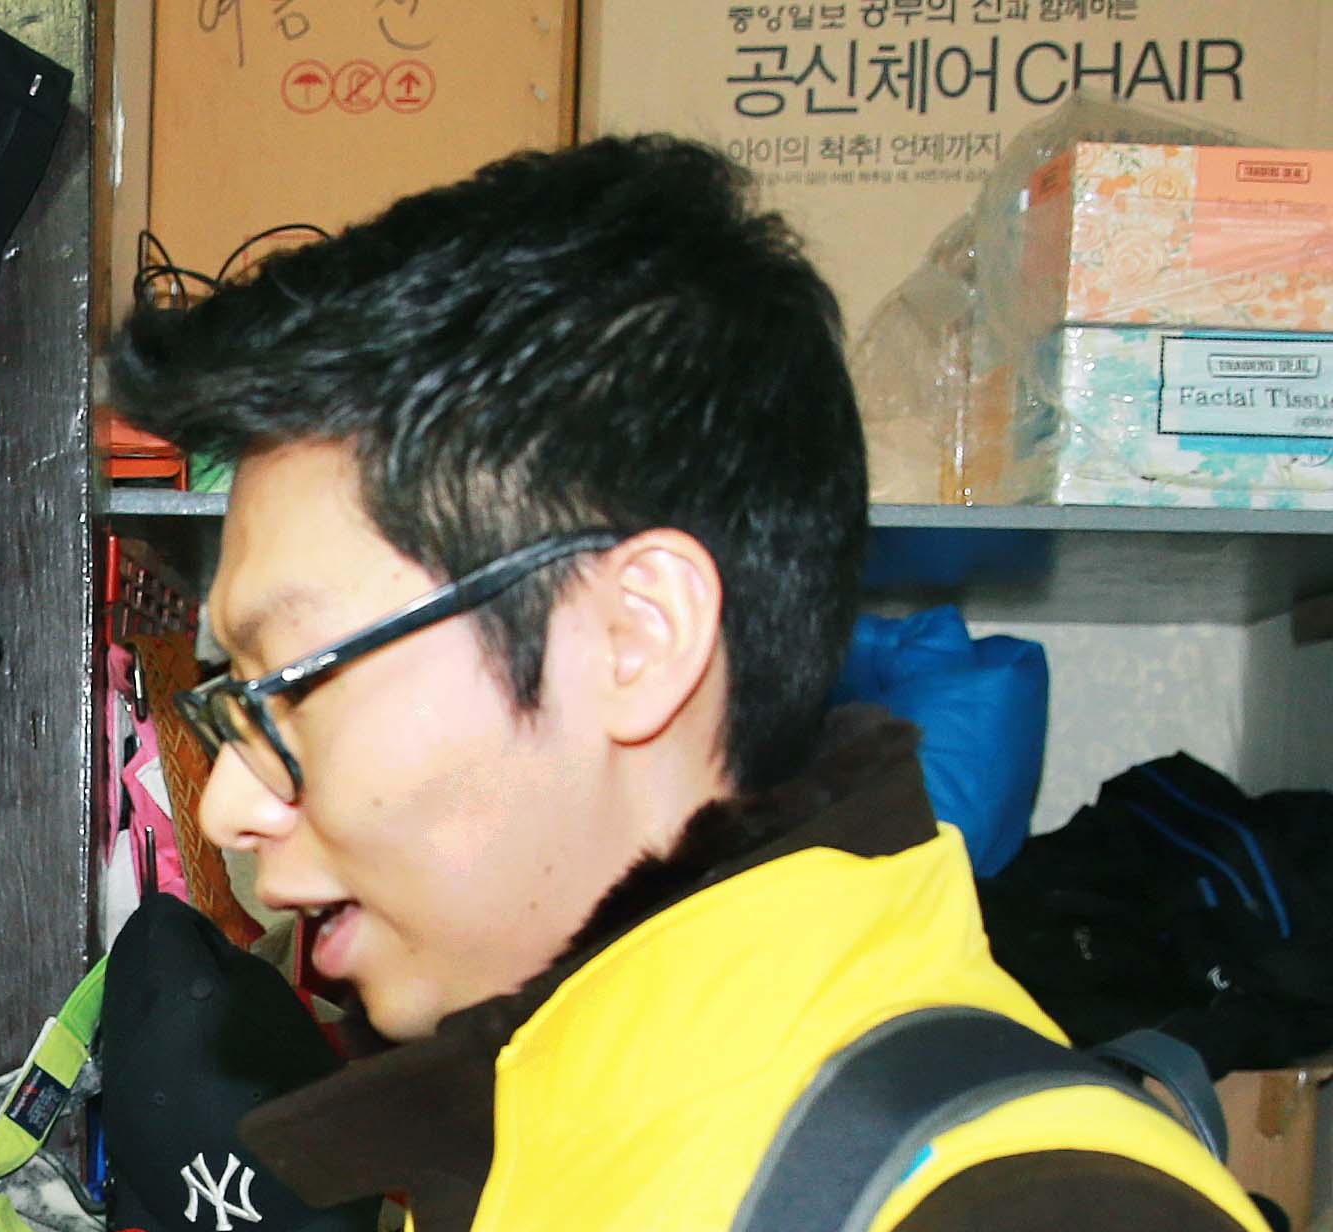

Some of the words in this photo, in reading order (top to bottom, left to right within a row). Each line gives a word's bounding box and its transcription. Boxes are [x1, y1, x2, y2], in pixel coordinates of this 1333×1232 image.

[728, 5, 846, 33] 중앙일보
[727, 37, 999, 117] 공신체어
[1015, 37, 1244, 105] CHAIR
[1180, 386, 1255, 407] Facial
[180, 1152, 263, 1232] NY
